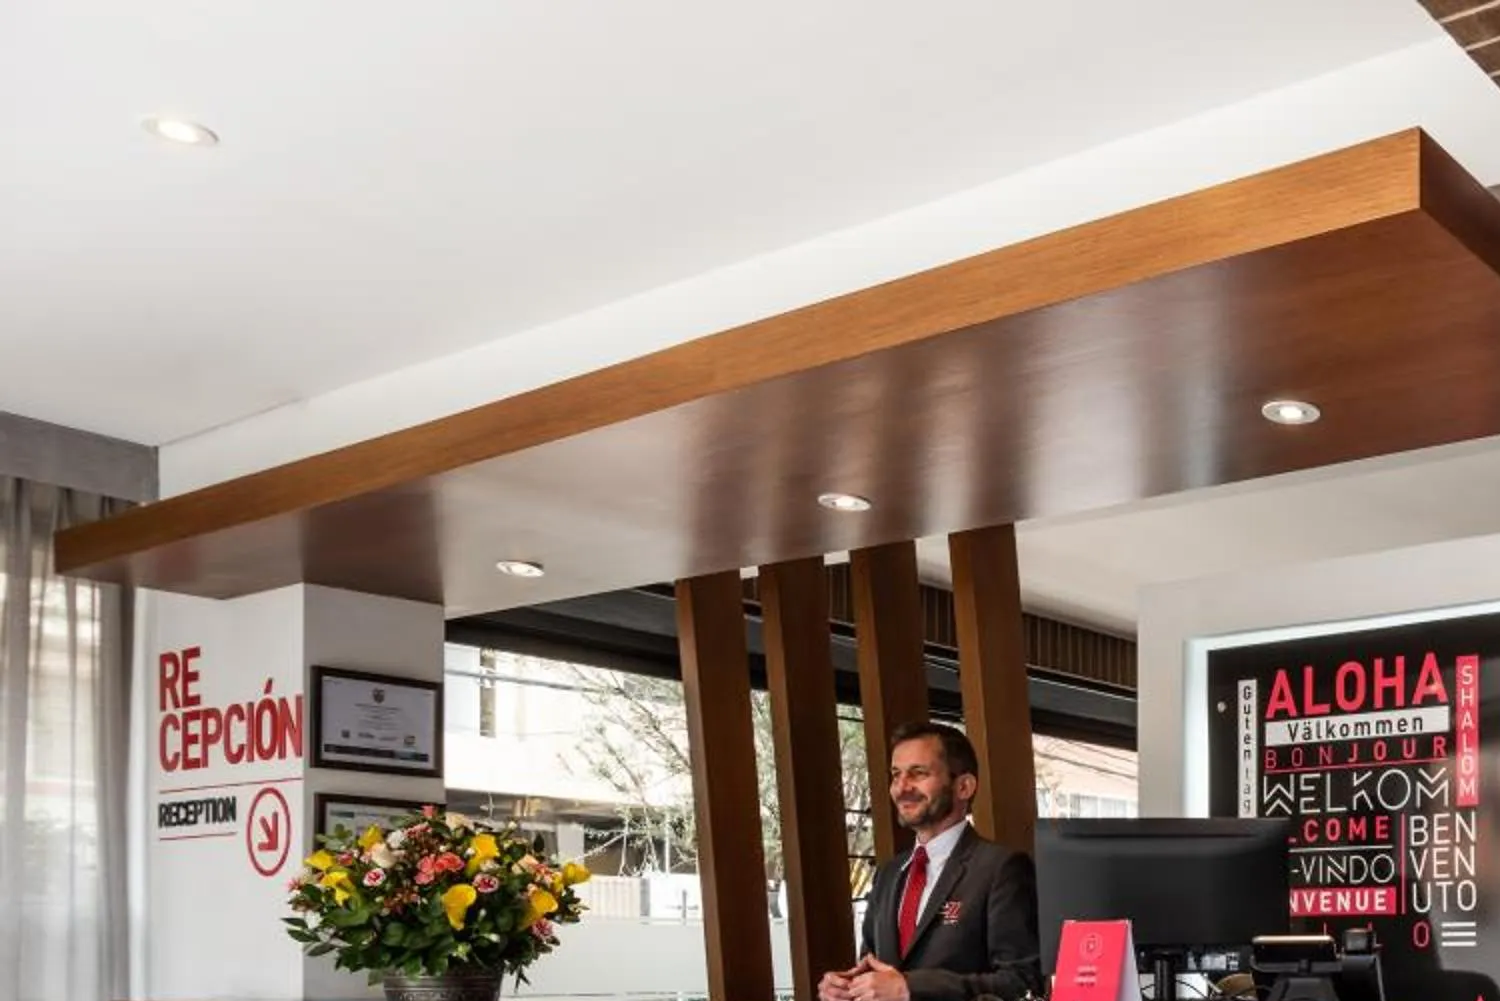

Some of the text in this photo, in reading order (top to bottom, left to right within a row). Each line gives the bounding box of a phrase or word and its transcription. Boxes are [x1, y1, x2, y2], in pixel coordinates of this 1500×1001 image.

[159, 646, 201, 711] RE
[1265, 651, 1449, 719] ALOHA
[159, 677, 303, 773] CEPCIÓN
[1287, 715, 1423, 742] Välkommen
[1460, 664, 1475, 798] SHALOM
[1265, 735, 1447, 769] BONJOUR
[1263, 767, 1449, 817] WELKOM
[158, 796, 237, 828] RECEPTION
[1409, 811, 1477, 846] BEN
[1288, 815, 1389, 844] COME
[1409, 846, 1477, 879] VEN
[1412, 880, 1477, 913] UTO
